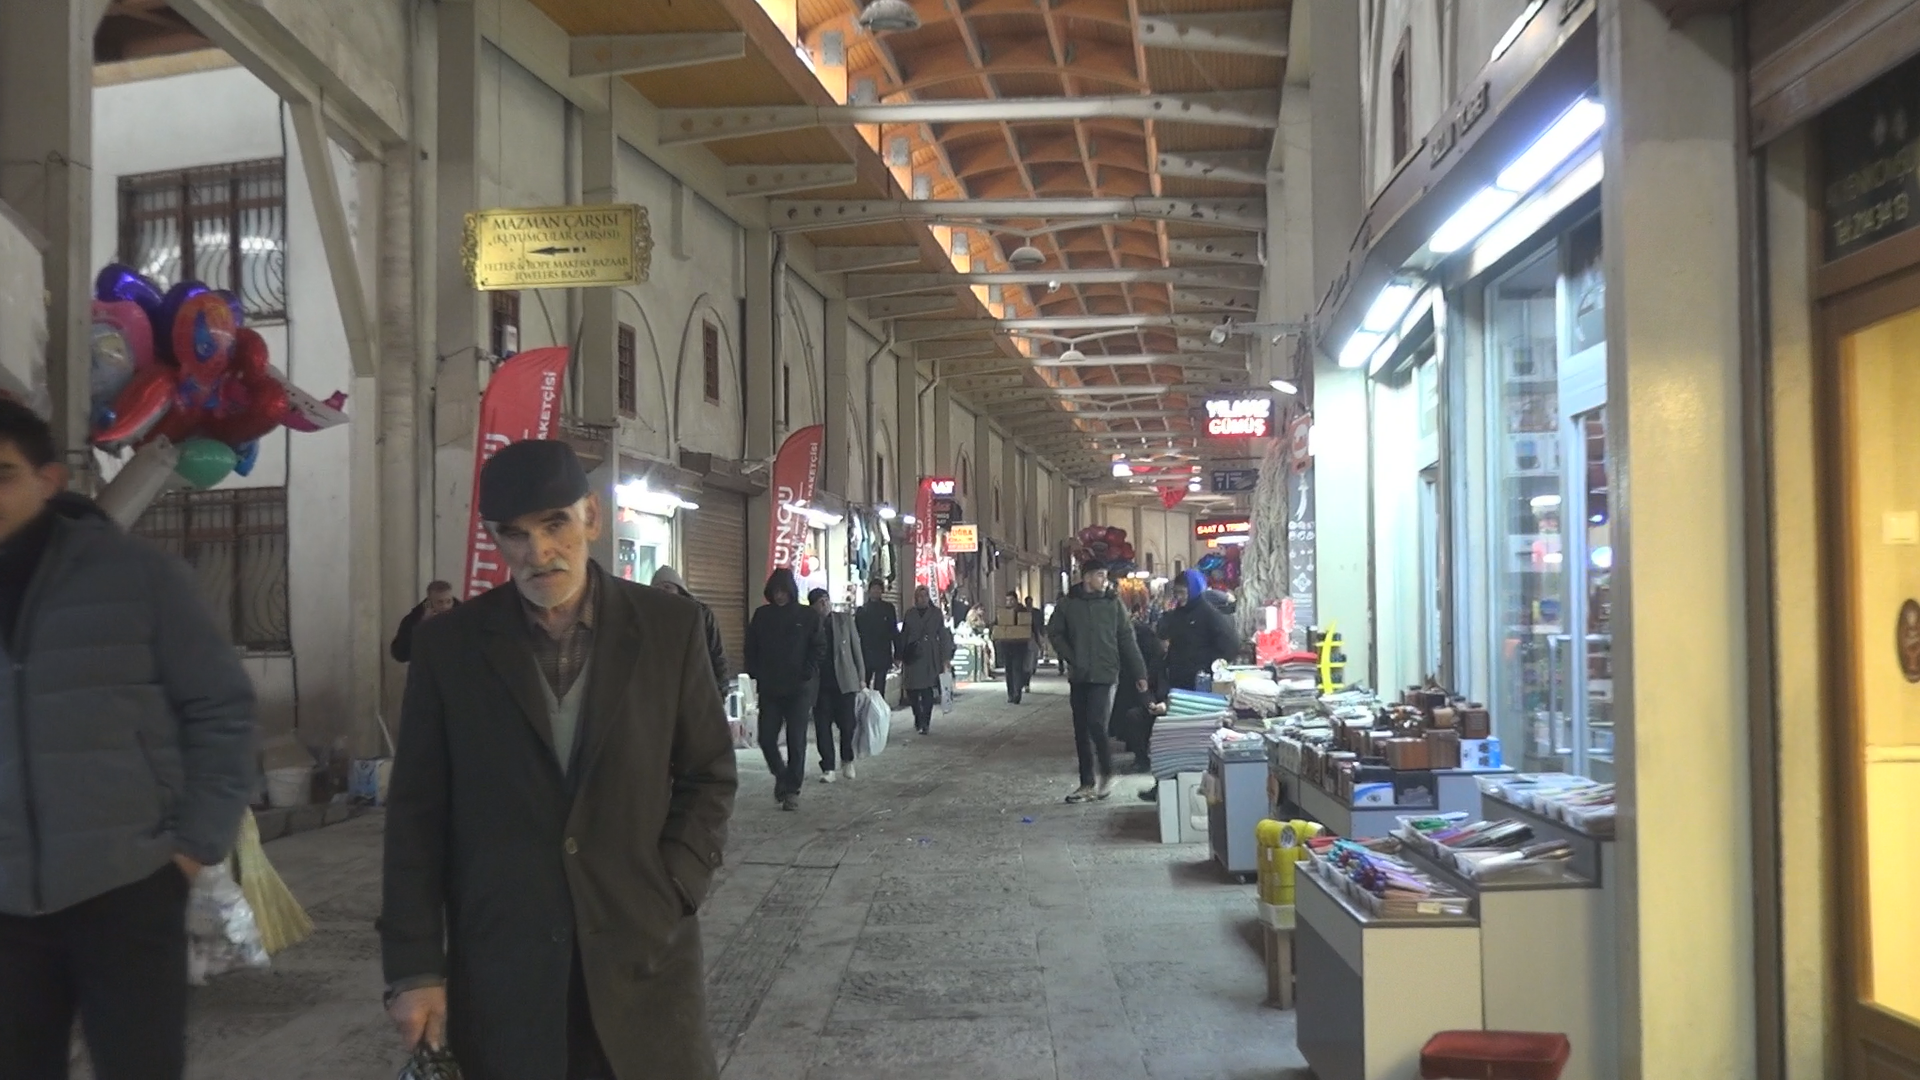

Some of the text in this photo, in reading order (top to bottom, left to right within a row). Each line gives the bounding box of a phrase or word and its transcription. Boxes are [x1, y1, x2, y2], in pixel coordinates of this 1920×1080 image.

[493, 213, 618, 231] MAZMAN ÇARŞISI
[517, 261, 525, 271] &
[526, 259, 550, 270] ROPE
[553, 258, 591, 268] MAKERS
[593, 256, 629, 267] BAZAAR
[561, 268, 597, 279] BAZAAR
[773, 486, 794, 570] ÜNCÜ
